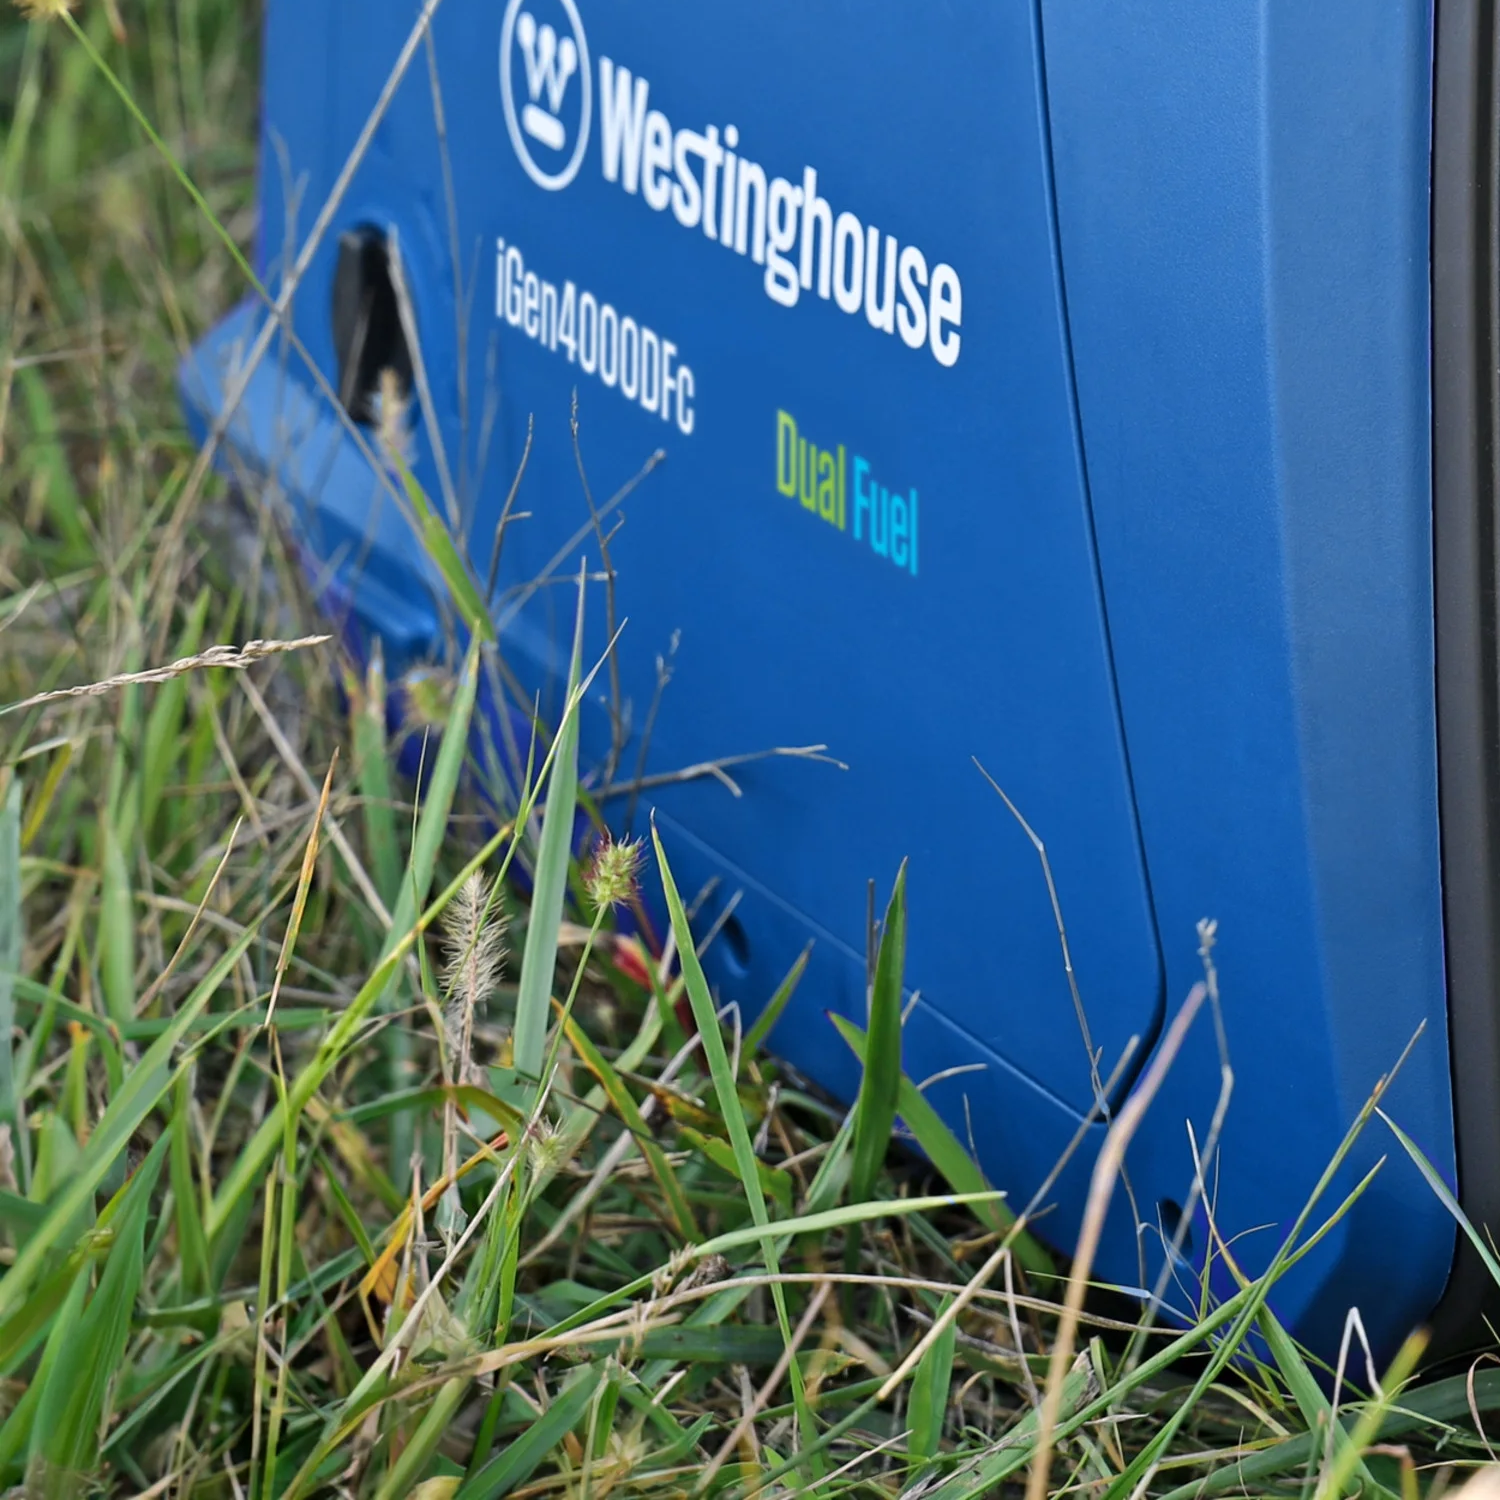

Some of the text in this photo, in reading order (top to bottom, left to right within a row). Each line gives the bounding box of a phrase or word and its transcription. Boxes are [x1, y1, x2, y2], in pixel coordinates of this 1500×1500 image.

[600, 55, 963, 367] Westinghouse
[777, 407, 919, 578] Dual Fuel
